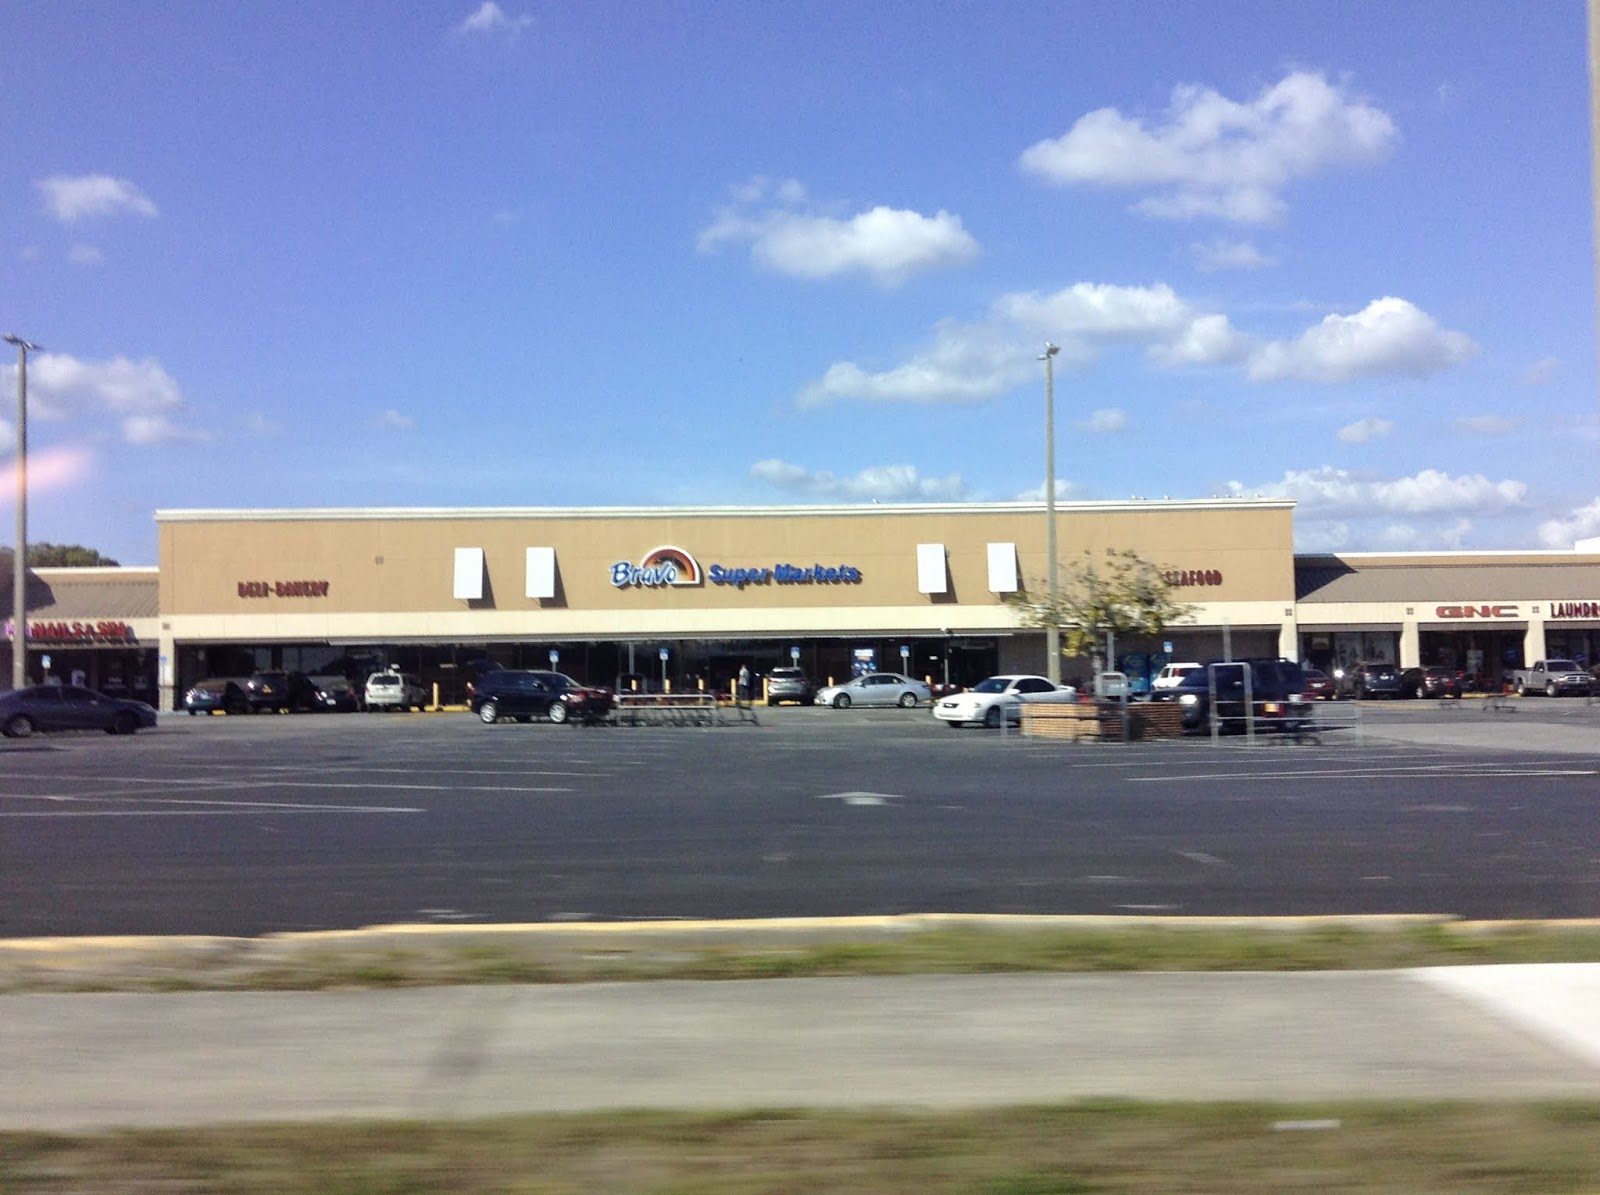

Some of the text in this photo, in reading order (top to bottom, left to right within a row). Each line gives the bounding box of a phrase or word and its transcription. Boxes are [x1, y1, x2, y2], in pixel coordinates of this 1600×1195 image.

[608, 560, 859, 586] Bravo Super Markets
[1436, 605, 1519, 618] GNC
[1550, 602, 1600, 619] LAUNDR
[33, 621, 84, 639] NAILS
[97, 620, 128, 637] SPA
